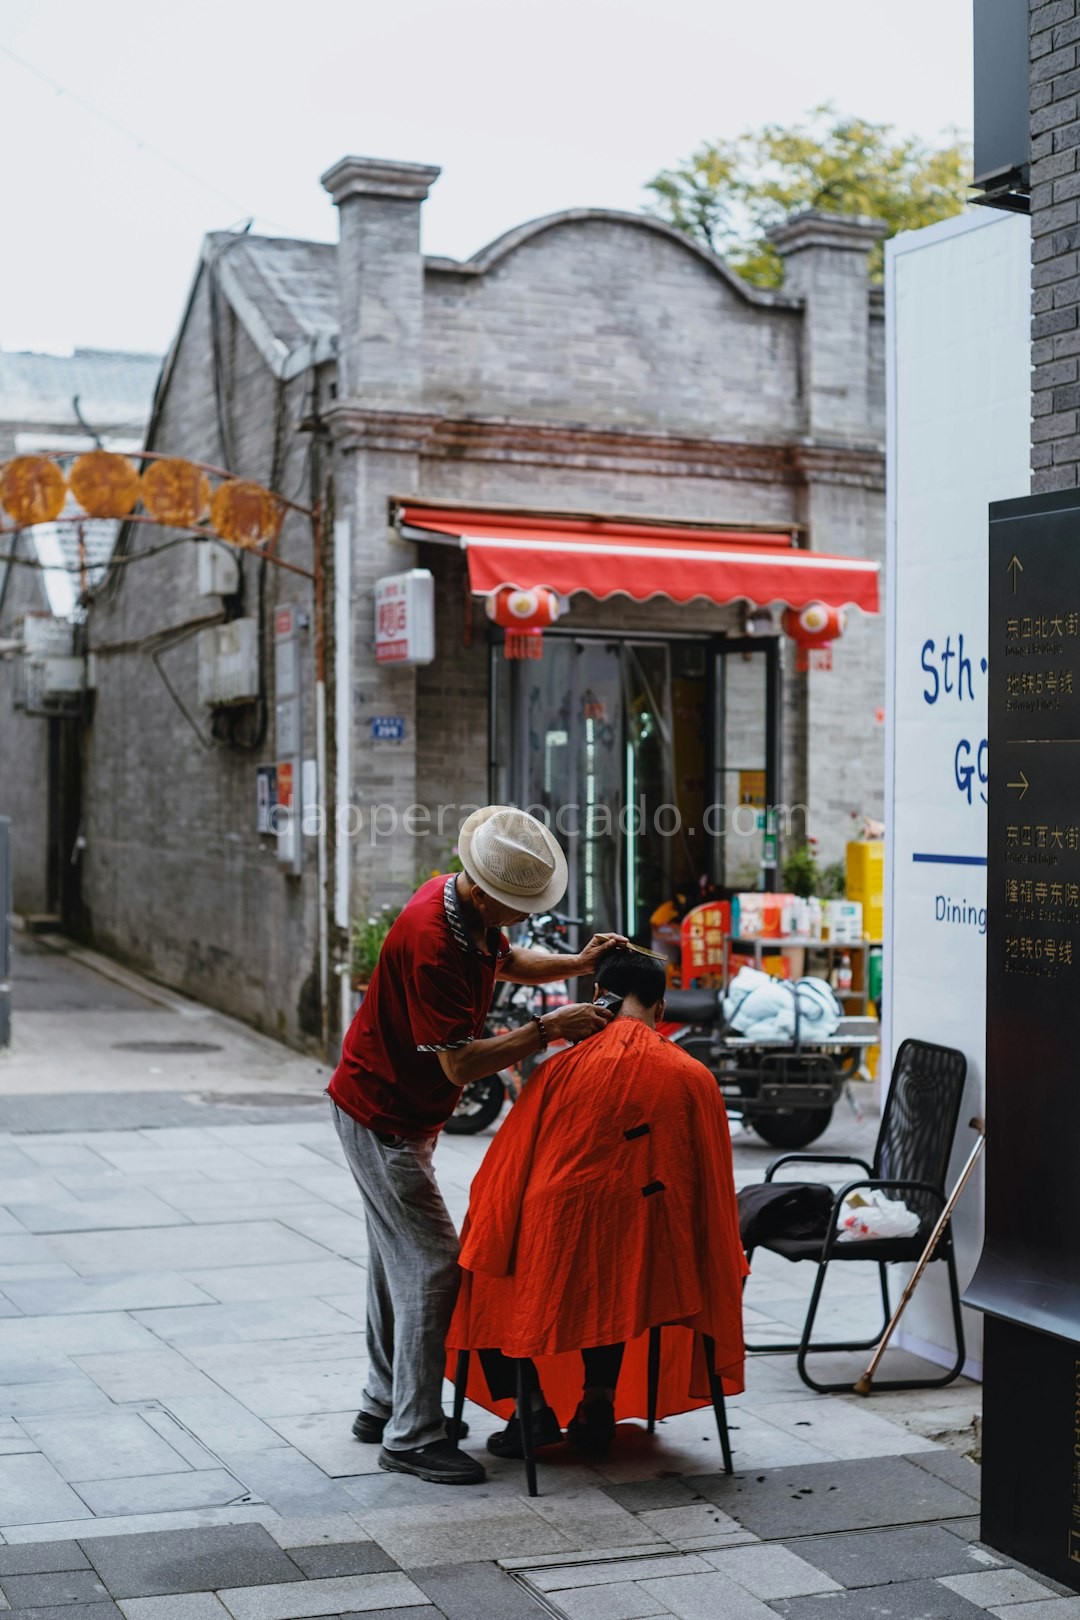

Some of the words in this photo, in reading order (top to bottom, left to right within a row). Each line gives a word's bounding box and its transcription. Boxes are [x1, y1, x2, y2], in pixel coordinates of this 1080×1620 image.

[1006, 612, 1079, 641] 东四北大街
[1006, 670, 1073, 696] 地铁5号线
[1006, 825, 1079, 850] 东四西大街
[1005, 879, 1080, 908] 隆福寺东院
[935, 895, 987, 934] Dining
[1006, 936, 1073, 965] 地铁6号线
